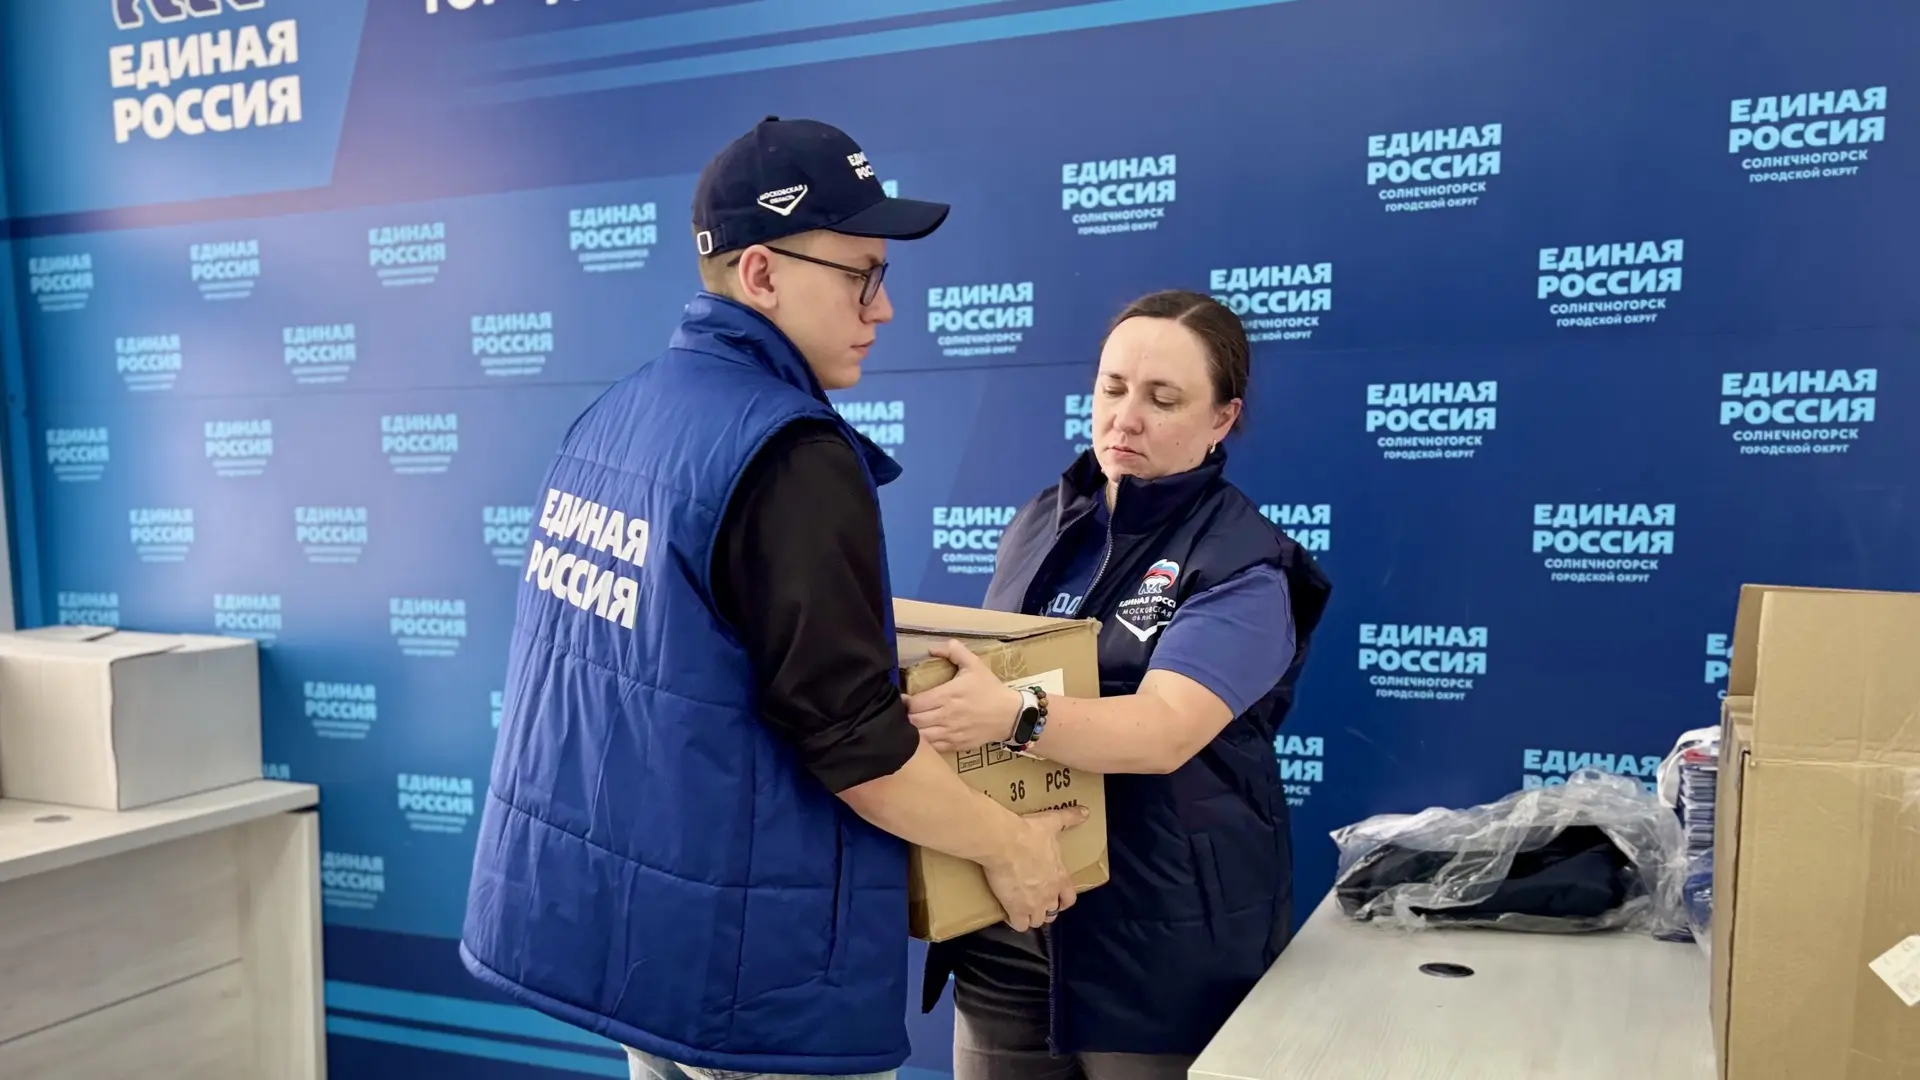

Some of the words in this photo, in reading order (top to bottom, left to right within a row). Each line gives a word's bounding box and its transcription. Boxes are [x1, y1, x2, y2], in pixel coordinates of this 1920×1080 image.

[108, 19, 299, 90] ЕДИНАЯ
[112, 75, 302, 144] РОССИЯ
[1730, 86, 1887, 124] ЕДИНАЯ
[1367, 123, 1502, 158] ЕДИНАЯ
[1728, 116, 1885, 153] РОССИЯ
[847, 151, 868, 167] ЕДИ
[1062, 154, 1176, 186] ЕДИНАЯ
[1367, 151, 1501, 185] РОССИЯ
[1741, 149, 1869, 170] СОЛНЕЧНОГОРСК
[855, 164, 875, 180] РОС
[1749, 167, 1820, 182] ГОРОДСКОЙ
[1822, 166, 1859, 177] ОКРУГ
[1062, 179, 1176, 210] РОССИЯ
[1378, 181, 1487, 200] СОЛНЕЧНОГОРСК
[569, 202, 657, 230] ЕДИНАЯ
[1072, 207, 1165, 224] СОЛНЕЧНОГОРСК
[1385, 198, 1445, 212] ГОРОДСКОЙ
[1447, 197, 1479, 207] ОКРУГ
[367, 222, 445, 246] ЕДИНАЯ
[569, 224, 657, 252] РОССИЯ
[189, 239, 259, 263] ЕДИНАЯ
[369, 242, 446, 266] РОССИЯ
[1539, 239, 1684, 272] ЕДИНАЯ
[191, 258, 260, 281] РОССИЯ
[1210, 262, 1332, 292] ЕДИНАЯ
[1537, 267, 1682, 299] РОССИЯ
[928, 281, 1034, 310] ЕДИНАЯ
[1549, 298, 1667, 315] СОЛНЕЧНОГОРСК
[471, 311, 552, 335] ЕДИНАЯ
[928, 305, 1034, 333] РОССИЯ
[1556, 314, 1621, 327] ГОРОДСКОЙ
[1623, 313, 1658, 324] ОКРУГ
[282, 323, 356, 346] ЕДИНАЯ
[472, 332, 554, 355] РОССИЯ
[284, 343, 357, 365] РОССИЯ
[1367, 381, 1497, 407] ЕДИНАЯ
[1721, 368, 1878, 398] ЕДИНАЯ
[832, 401, 904, 423] ИНАЯ
[1366, 407, 1497, 432] РОССИЯ
[1720, 397, 1876, 425] РОССИЯ
[381, 414, 458, 434] ЕДИНАЯ
[1732, 428, 1859, 441] СОЛНЕЧНОГОРСК
[382, 433, 458, 453] РОССИЯ
[1377, 435, 1483, 447] СОЛНЕЧНОГОРСК
[1740, 443, 1811, 455] ГОРОДСКОЙ
[1813, 444, 1849, 454] ОКРУГ
[1384, 448, 1443, 460] ГОРОДСКОЙ
[1444, 449, 1475, 459] ОКРУГ
[294, 507, 368, 524] ЕДИНАЯ
[482, 505, 534, 525] ЕДИН
[933, 506, 1017, 528] ЕДИНА
[1259, 504, 1331, 526] НАЯ
[1534, 503, 1675, 528] ЕДИНАЯ
[296, 525, 368, 544] РОССИЯ
[483, 526, 530, 545] РОС
[539, 488, 649, 567] ЕДИНАЯ
[933, 528, 1004, 550] РОСС
[1533, 530, 1674, 554] РОССИЯ
[1544, 558, 1659, 570] СОЛНЕЧНОГОРСК
[525, 539, 638, 630] РОССИЯ
[1551, 571, 1615, 583] ГОРОДСКОЙ
[1616, 573, 1650, 583] ОКРУГ
[388, 598, 466, 617] ЕДИНАЯ
[1151, 595, 1177, 609] РОСС
[389, 616, 467, 638] РОССИЯ
[1359, 623, 1488, 648] ЕДИНАЯ
[1358, 648, 1487, 675] РОССИЯ
[303, 680, 376, 701] ЕДИНАЯ
[1369, 675, 1474, 689] СОЛНЕЧНОГОРСК
[1376, 688, 1434, 700] ГОРОДСКОЙ
[1435, 691, 1466, 701] ОКРУГ
[304, 700, 377, 721] РОССИЯ
[1523, 748, 1662, 777] ЕДИНАЯ
[397, 773, 474, 796] ЕДИНАЯ
[1010, 779, 1026, 802] 36
[1045, 767, 1072, 793] PCS
[398, 792, 474, 816] РОССИЯ
[323, 851, 384, 873] ДИНАЯ
[322, 871, 385, 893] ОССИЯ
